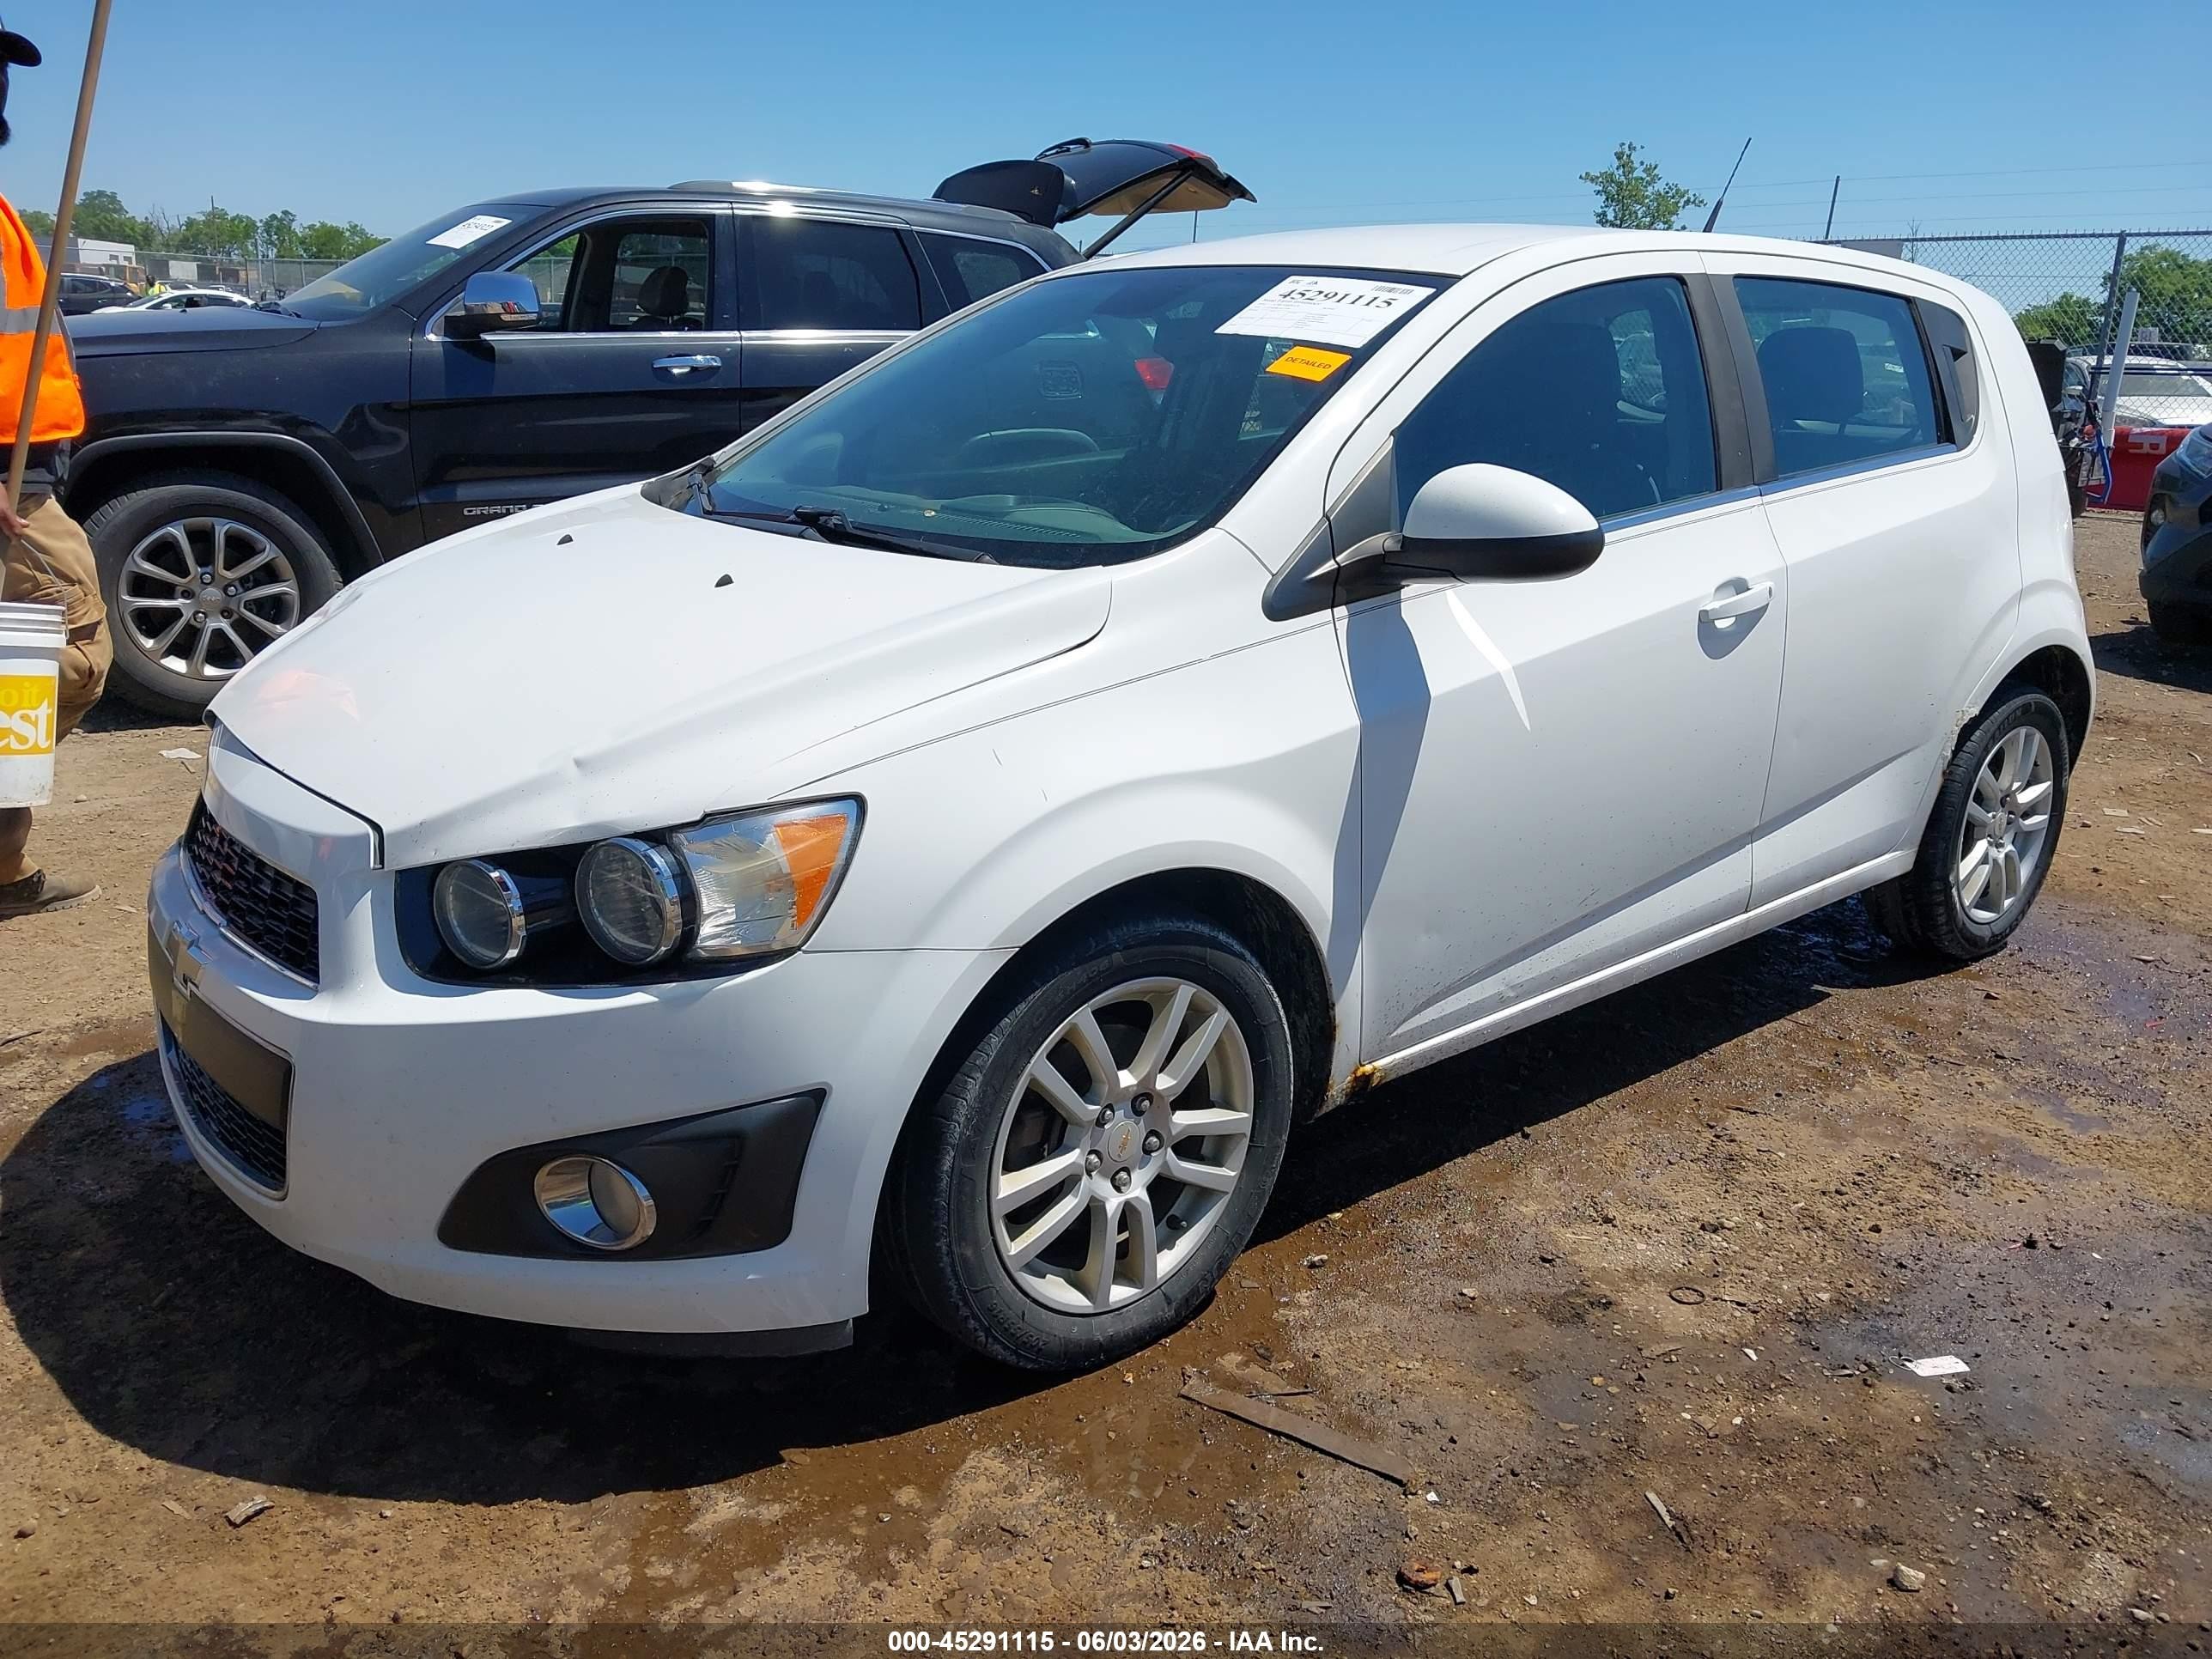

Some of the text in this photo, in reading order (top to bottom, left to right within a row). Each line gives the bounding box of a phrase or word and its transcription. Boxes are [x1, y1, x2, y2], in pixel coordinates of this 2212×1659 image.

[1278, 289, 1400, 309] 45291115
[1285, 356, 1333, 369] DETAILED
[463, 504, 527, 516] GRAND
